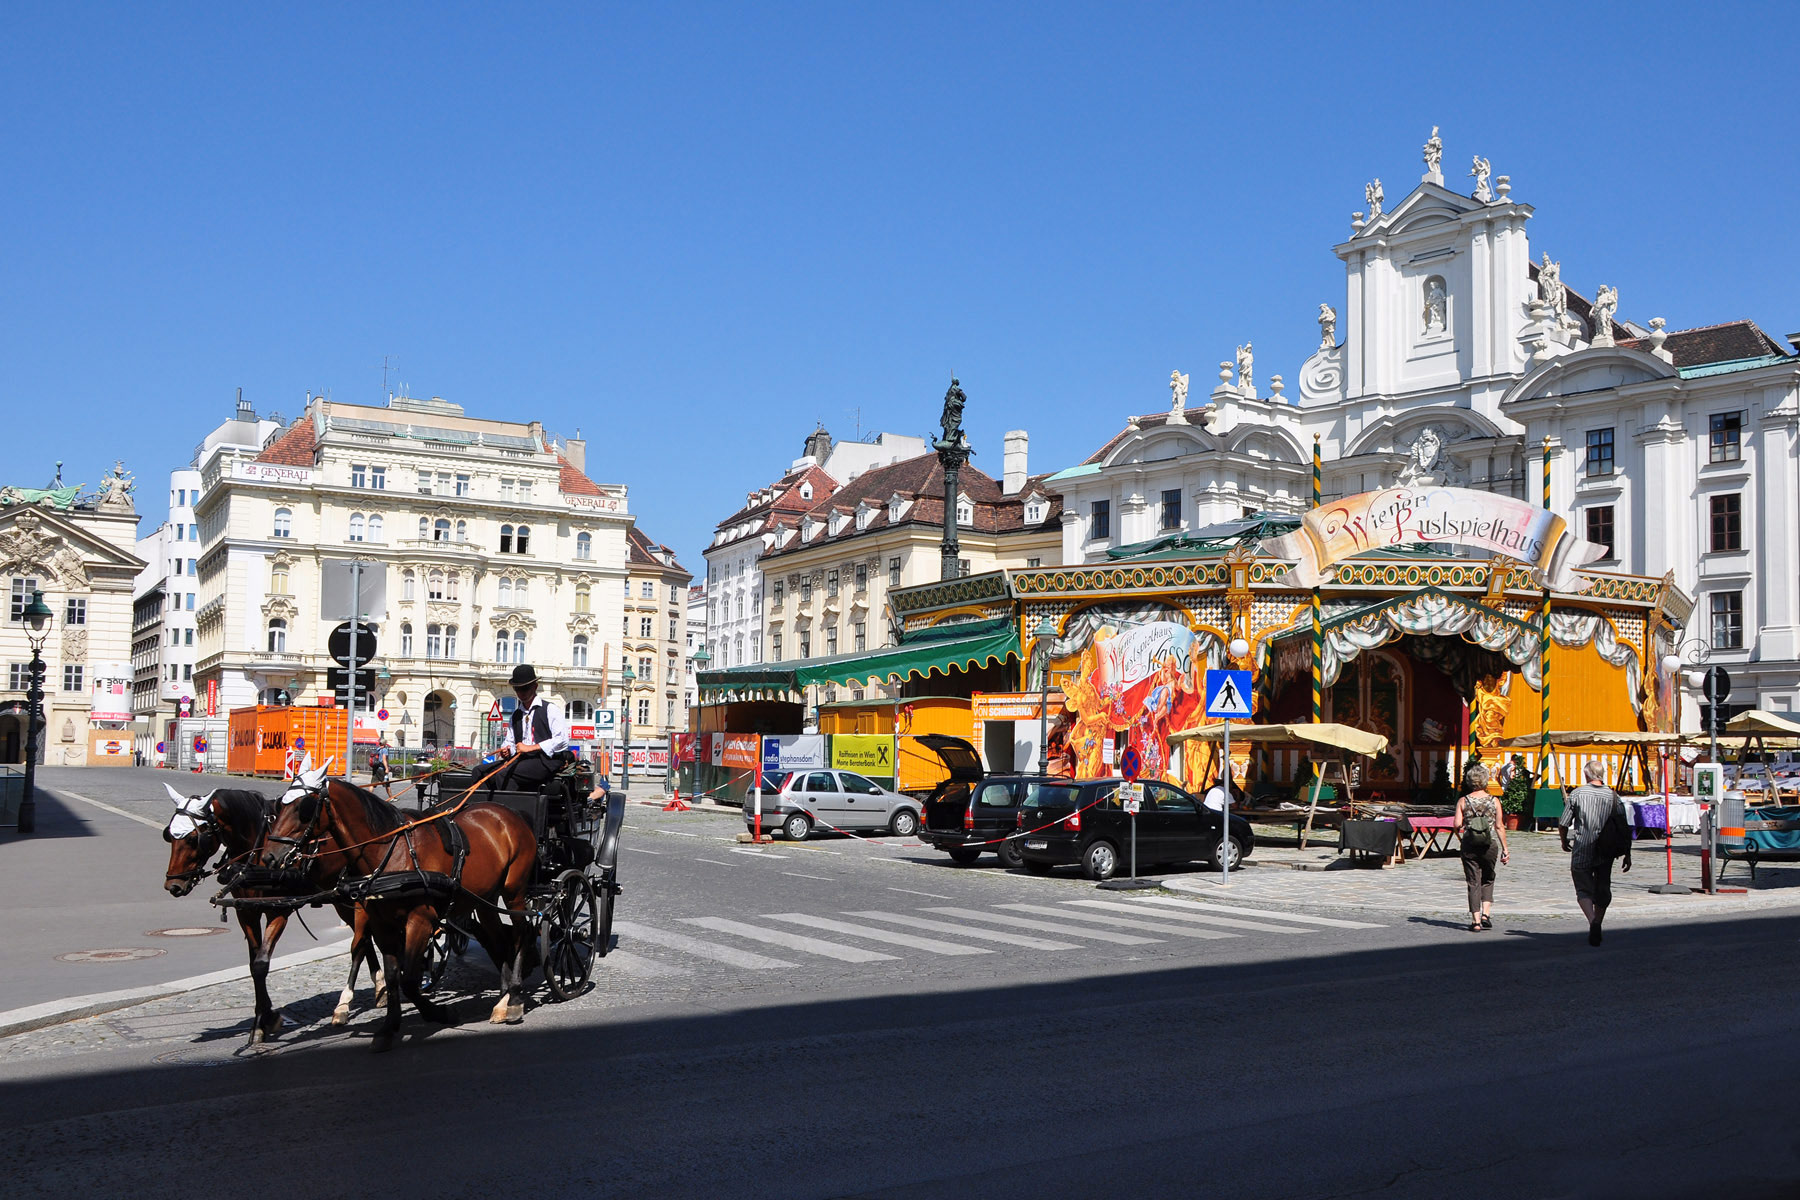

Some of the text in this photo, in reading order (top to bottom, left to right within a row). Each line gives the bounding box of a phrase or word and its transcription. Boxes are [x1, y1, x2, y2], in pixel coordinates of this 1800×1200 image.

[261, 467, 308, 480] GENERALI
[565, 496, 606, 508] GENERALI
[1317, 488, 1427, 551] Wiener
[973, 707, 988, 716] VON
[599, 711, 611, 724] P
[614, 752, 646, 762] STRBAG
[765, 754, 813, 763] radio stephansdom
[838, 750, 859, 758] Raiffeisen
[864, 751, 876, 759] Wien
[849, 759, 876, 767] BeraterBank
